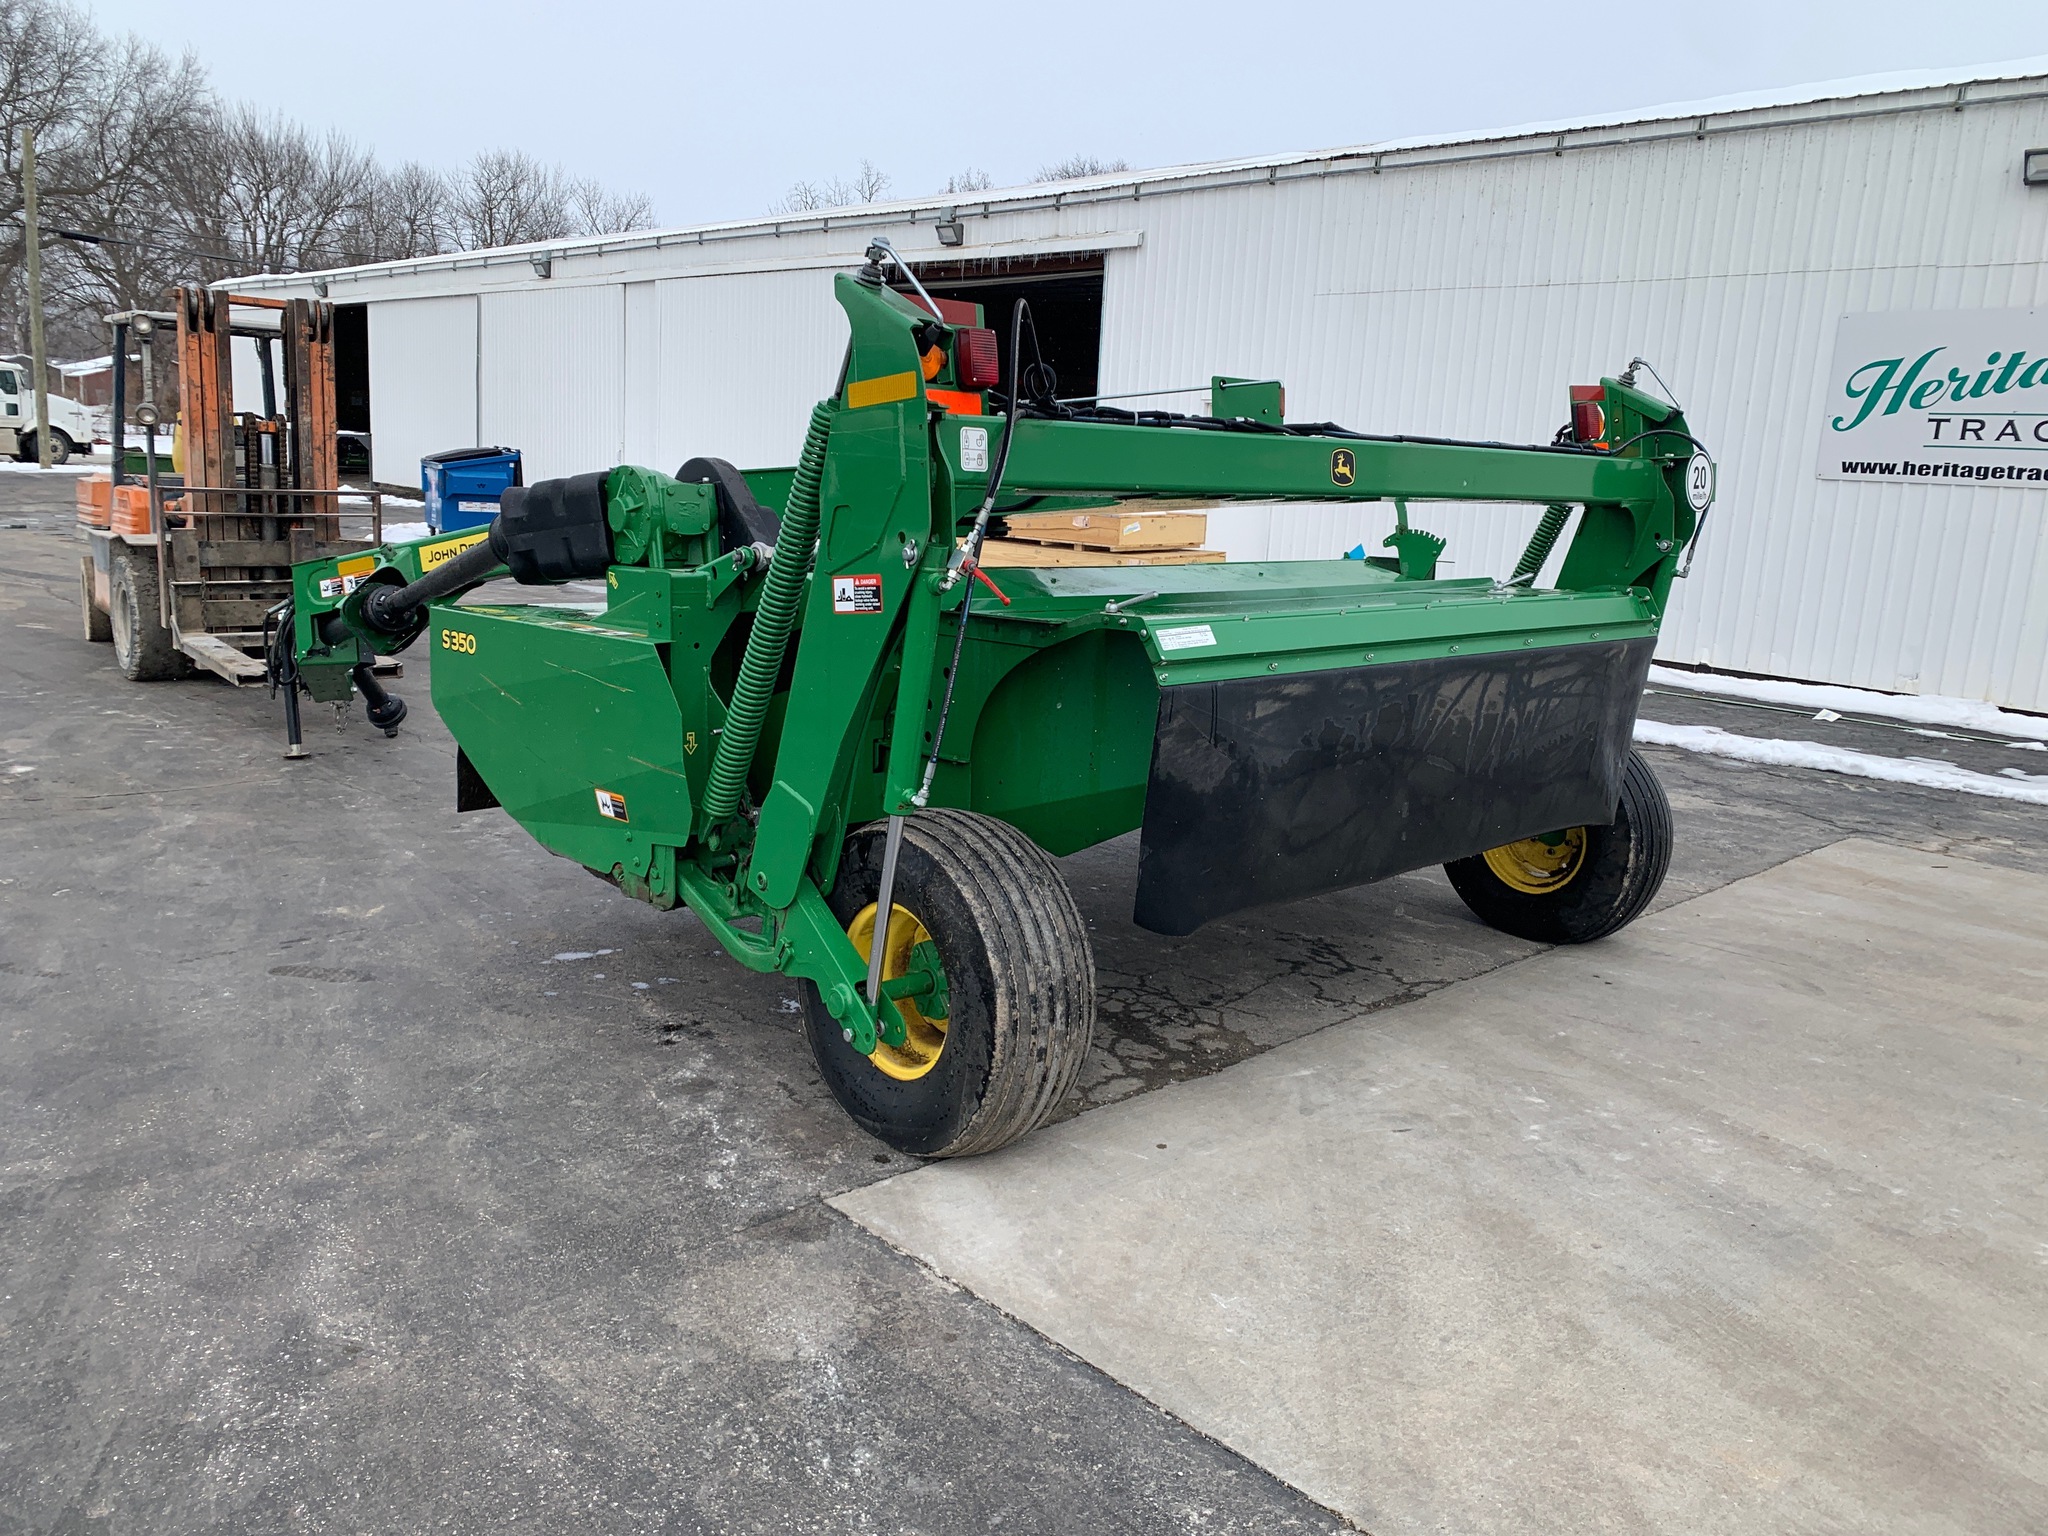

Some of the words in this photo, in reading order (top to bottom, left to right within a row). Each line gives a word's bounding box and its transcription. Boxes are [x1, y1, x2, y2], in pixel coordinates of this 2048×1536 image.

[1832, 346, 2048, 432] Herita
[1693, 466, 1706, 489] 20
[428, 547, 458, 563] JOHN
